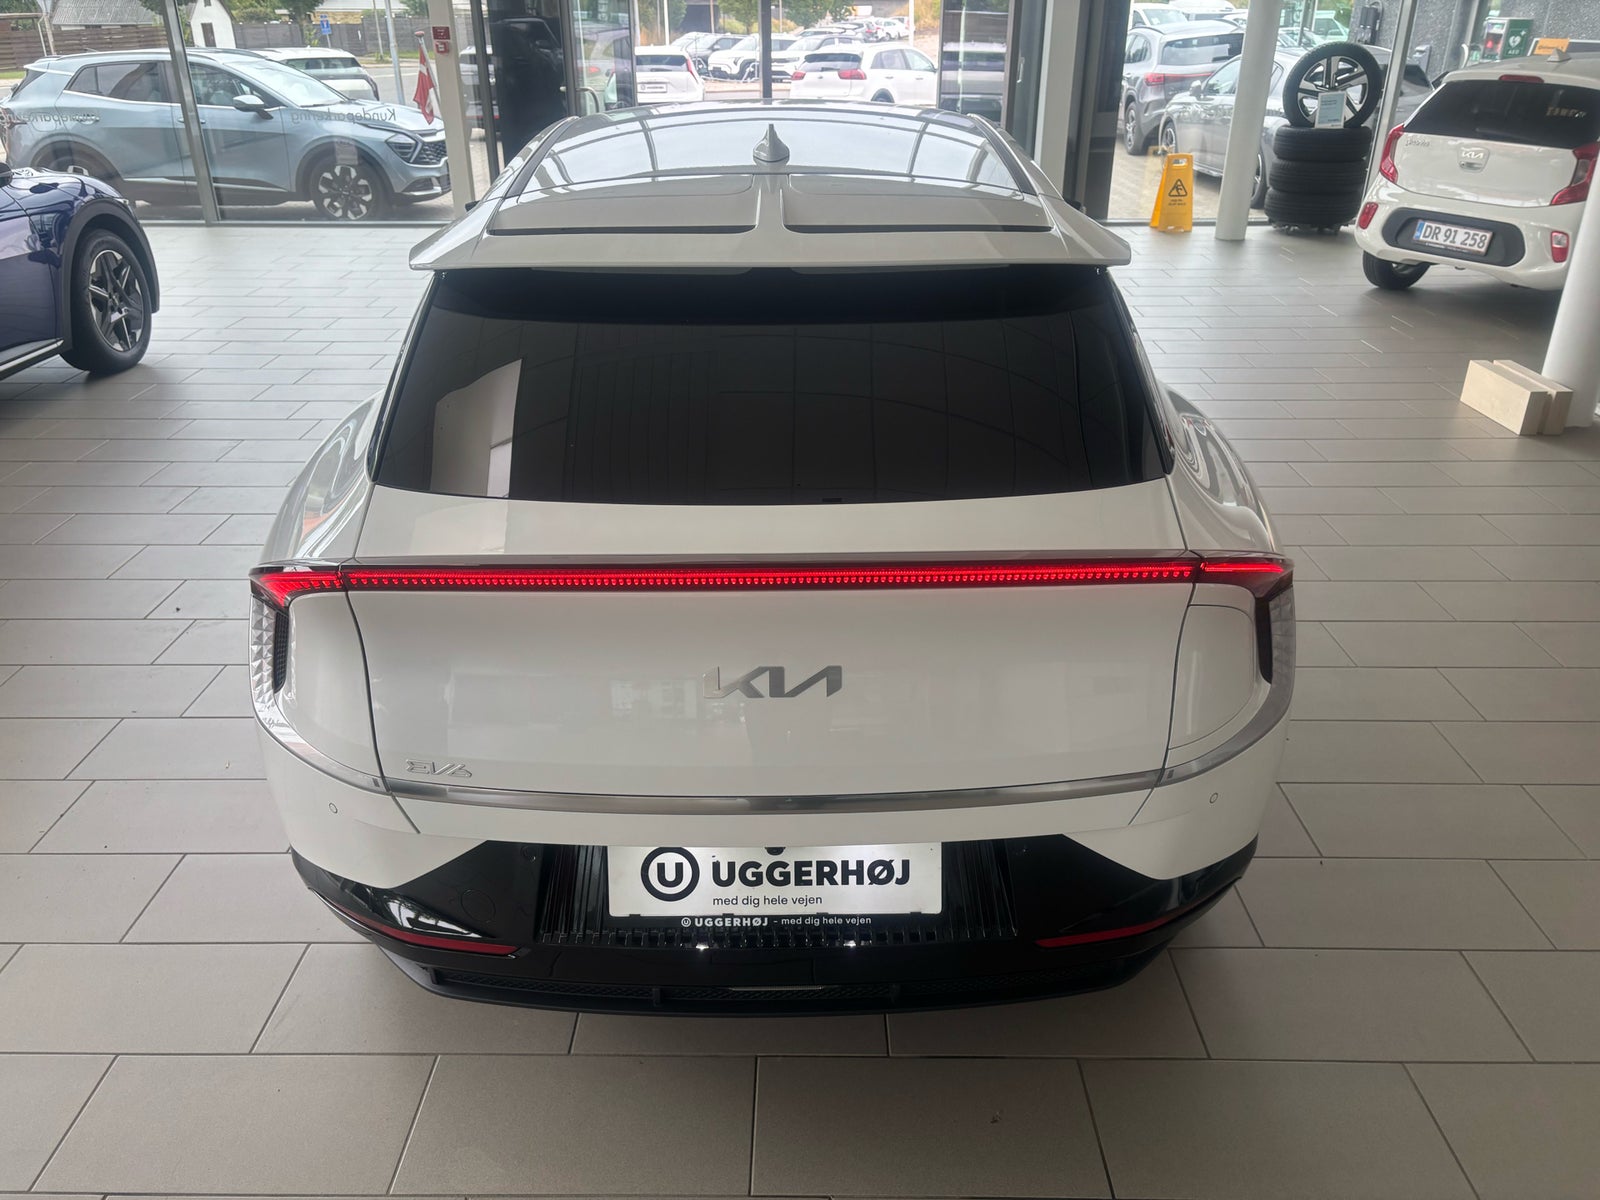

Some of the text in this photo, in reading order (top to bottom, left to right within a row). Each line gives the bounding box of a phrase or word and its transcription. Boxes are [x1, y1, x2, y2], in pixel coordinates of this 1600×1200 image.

[1422, 224, 1442, 241] DR
[1443, 228, 1459, 244] 91
[1460, 231, 1488, 250] 258
[703, 666, 842, 698] KIA
[406, 759, 472, 778] EV6
[711, 858, 911, 887] UGGERHØJ
[712, 895, 823, 908] med dig hele vejen
[694, 916, 769, 927] UGGERHØJ
[780, 916, 802, 926] med
[804, 916, 820, 927] dig
[822, 915, 843, 925] hele
[845, 916, 872, 926] vejen
